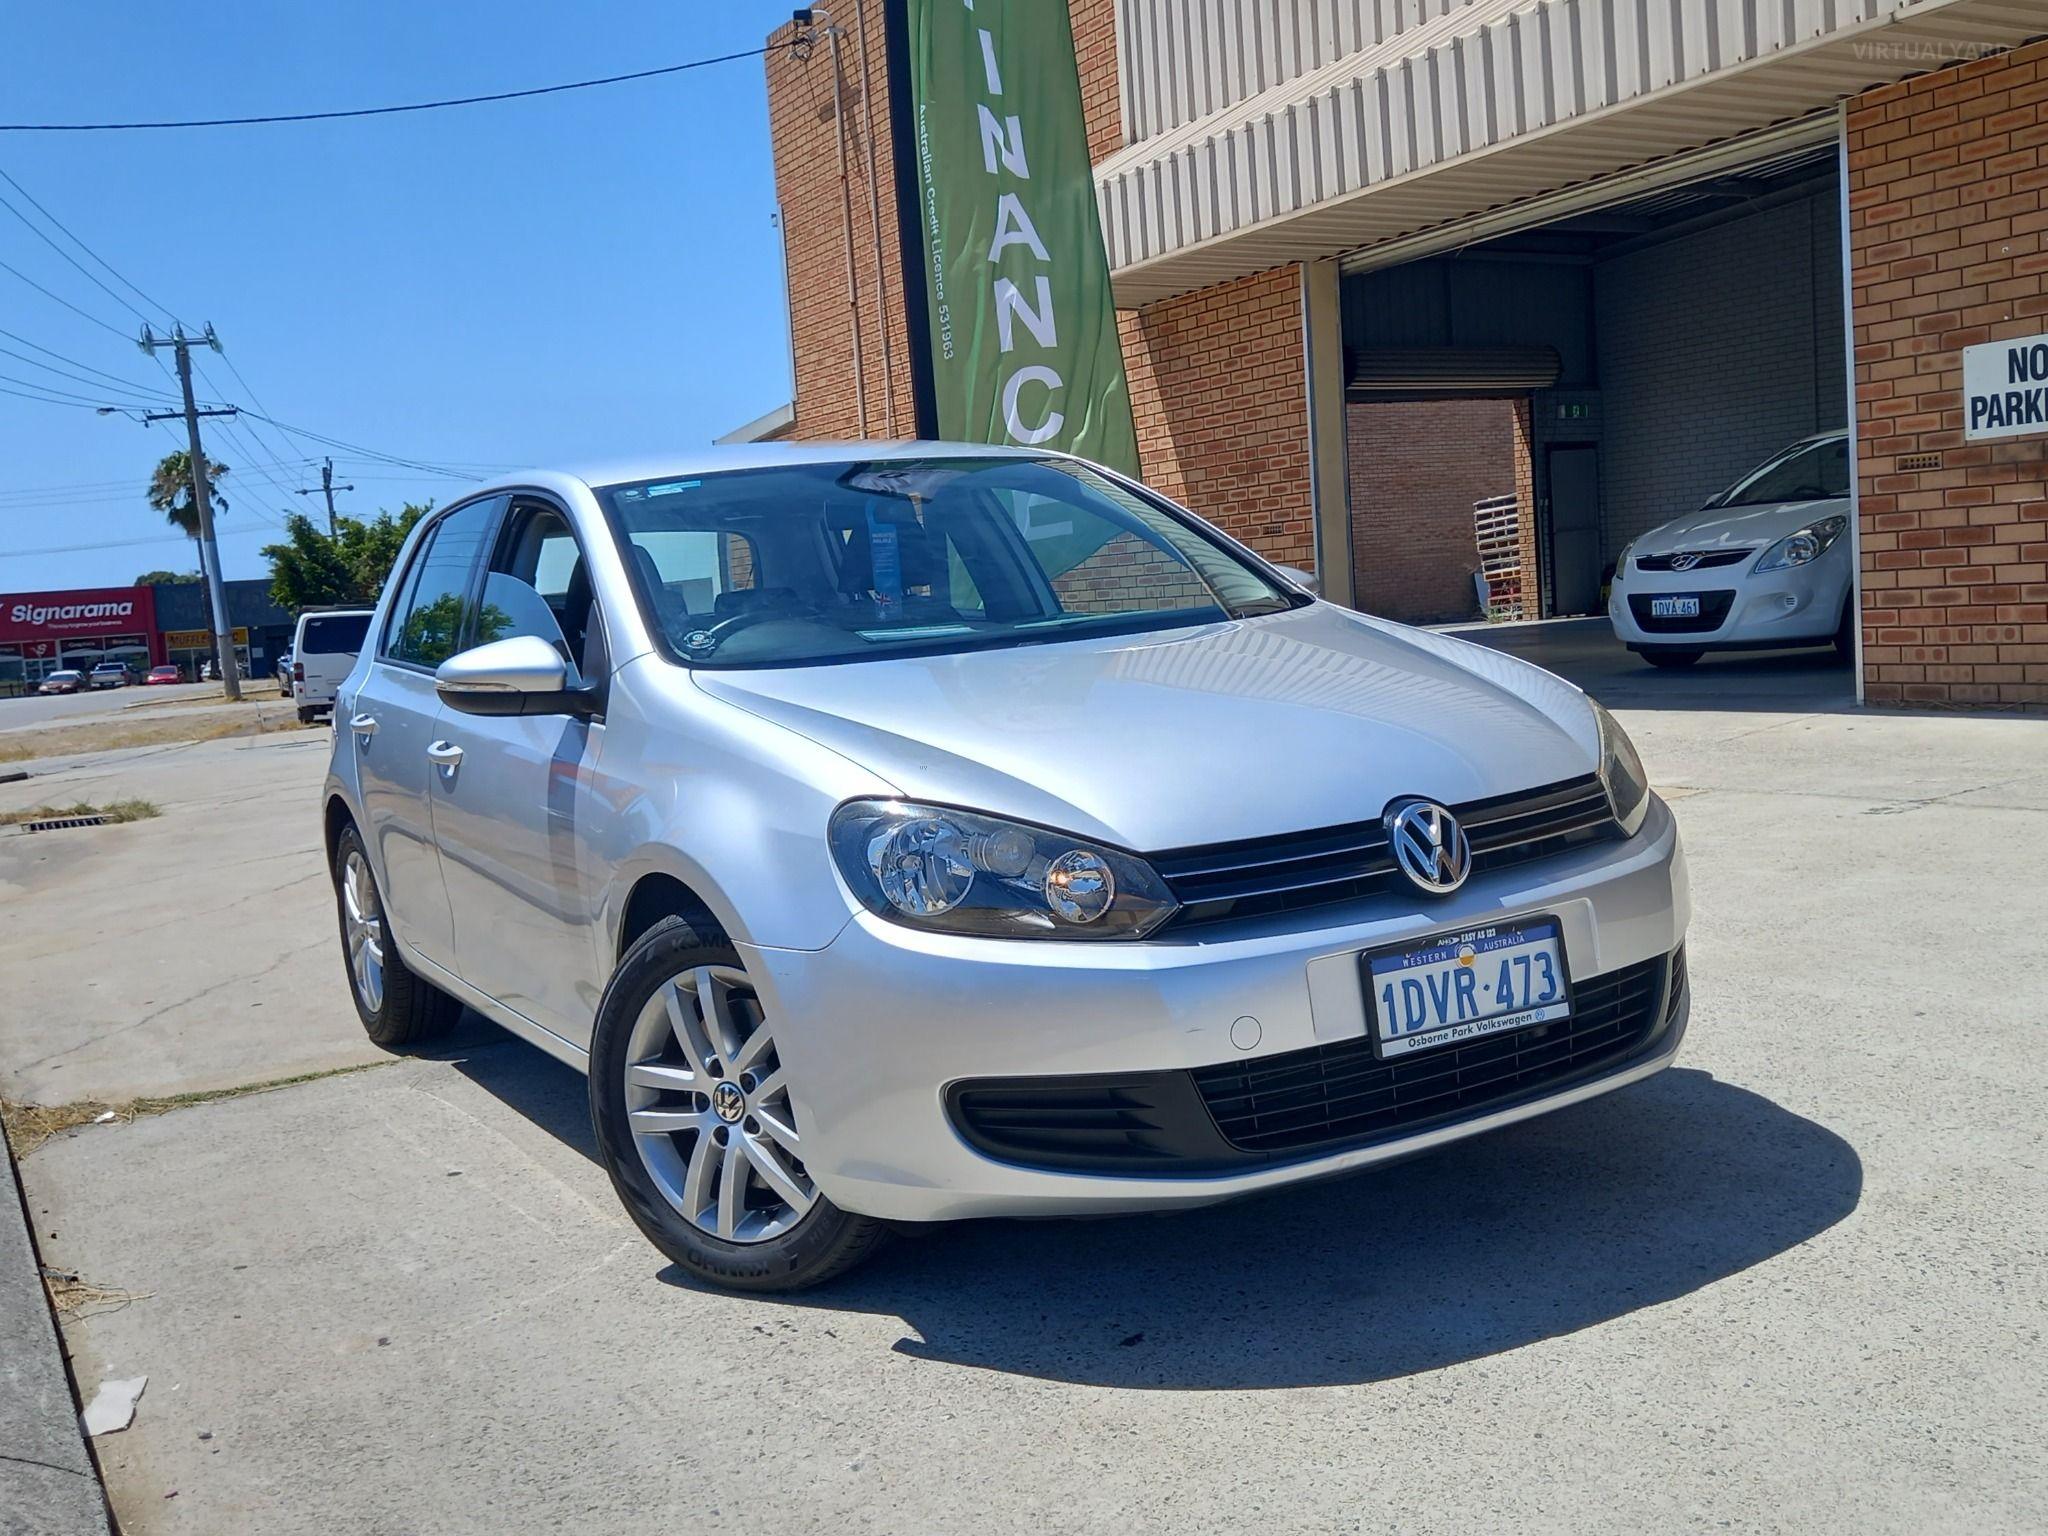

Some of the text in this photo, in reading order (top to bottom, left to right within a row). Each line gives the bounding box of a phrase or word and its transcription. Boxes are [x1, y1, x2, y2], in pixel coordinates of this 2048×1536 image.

[919, 104, 954, 360] Australian Credit Licence 531963
[963, 0, 1065, 444] INANC
[2008, 343, 2048, 384] NO
[11, 602, 133, 625] Signarama
[169, 631, 209, 647] MUFFLE
[1402, 935, 1525, 968] WESTERN AUSTRALIA
[1461, 931, 1475, 943] EASY
[1477, 930, 1486, 940] AS
[1486, 927, 1497, 938] 123
[1408, 1013, 1532, 1048] Osborne Park Volkswagen
